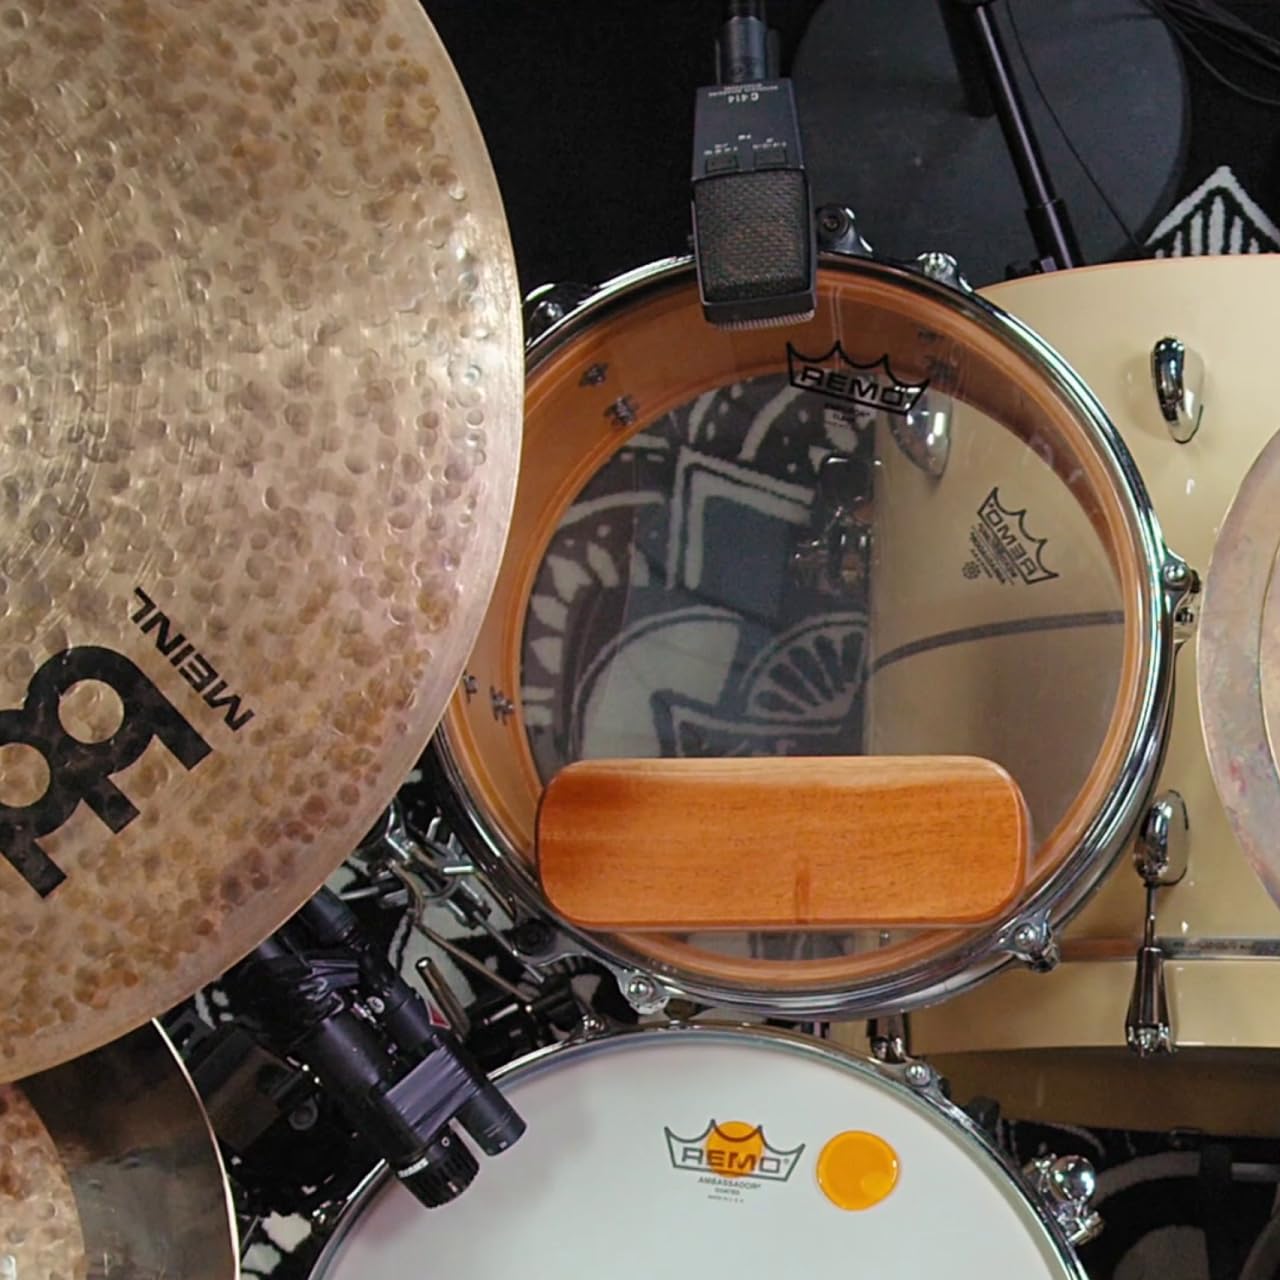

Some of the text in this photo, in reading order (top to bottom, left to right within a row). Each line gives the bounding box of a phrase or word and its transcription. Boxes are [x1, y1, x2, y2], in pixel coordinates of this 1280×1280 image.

[800, 365, 904, 407] REMO
[131, 585, 256, 732] MEINL
[681, 1146, 782, 1174] REMO
